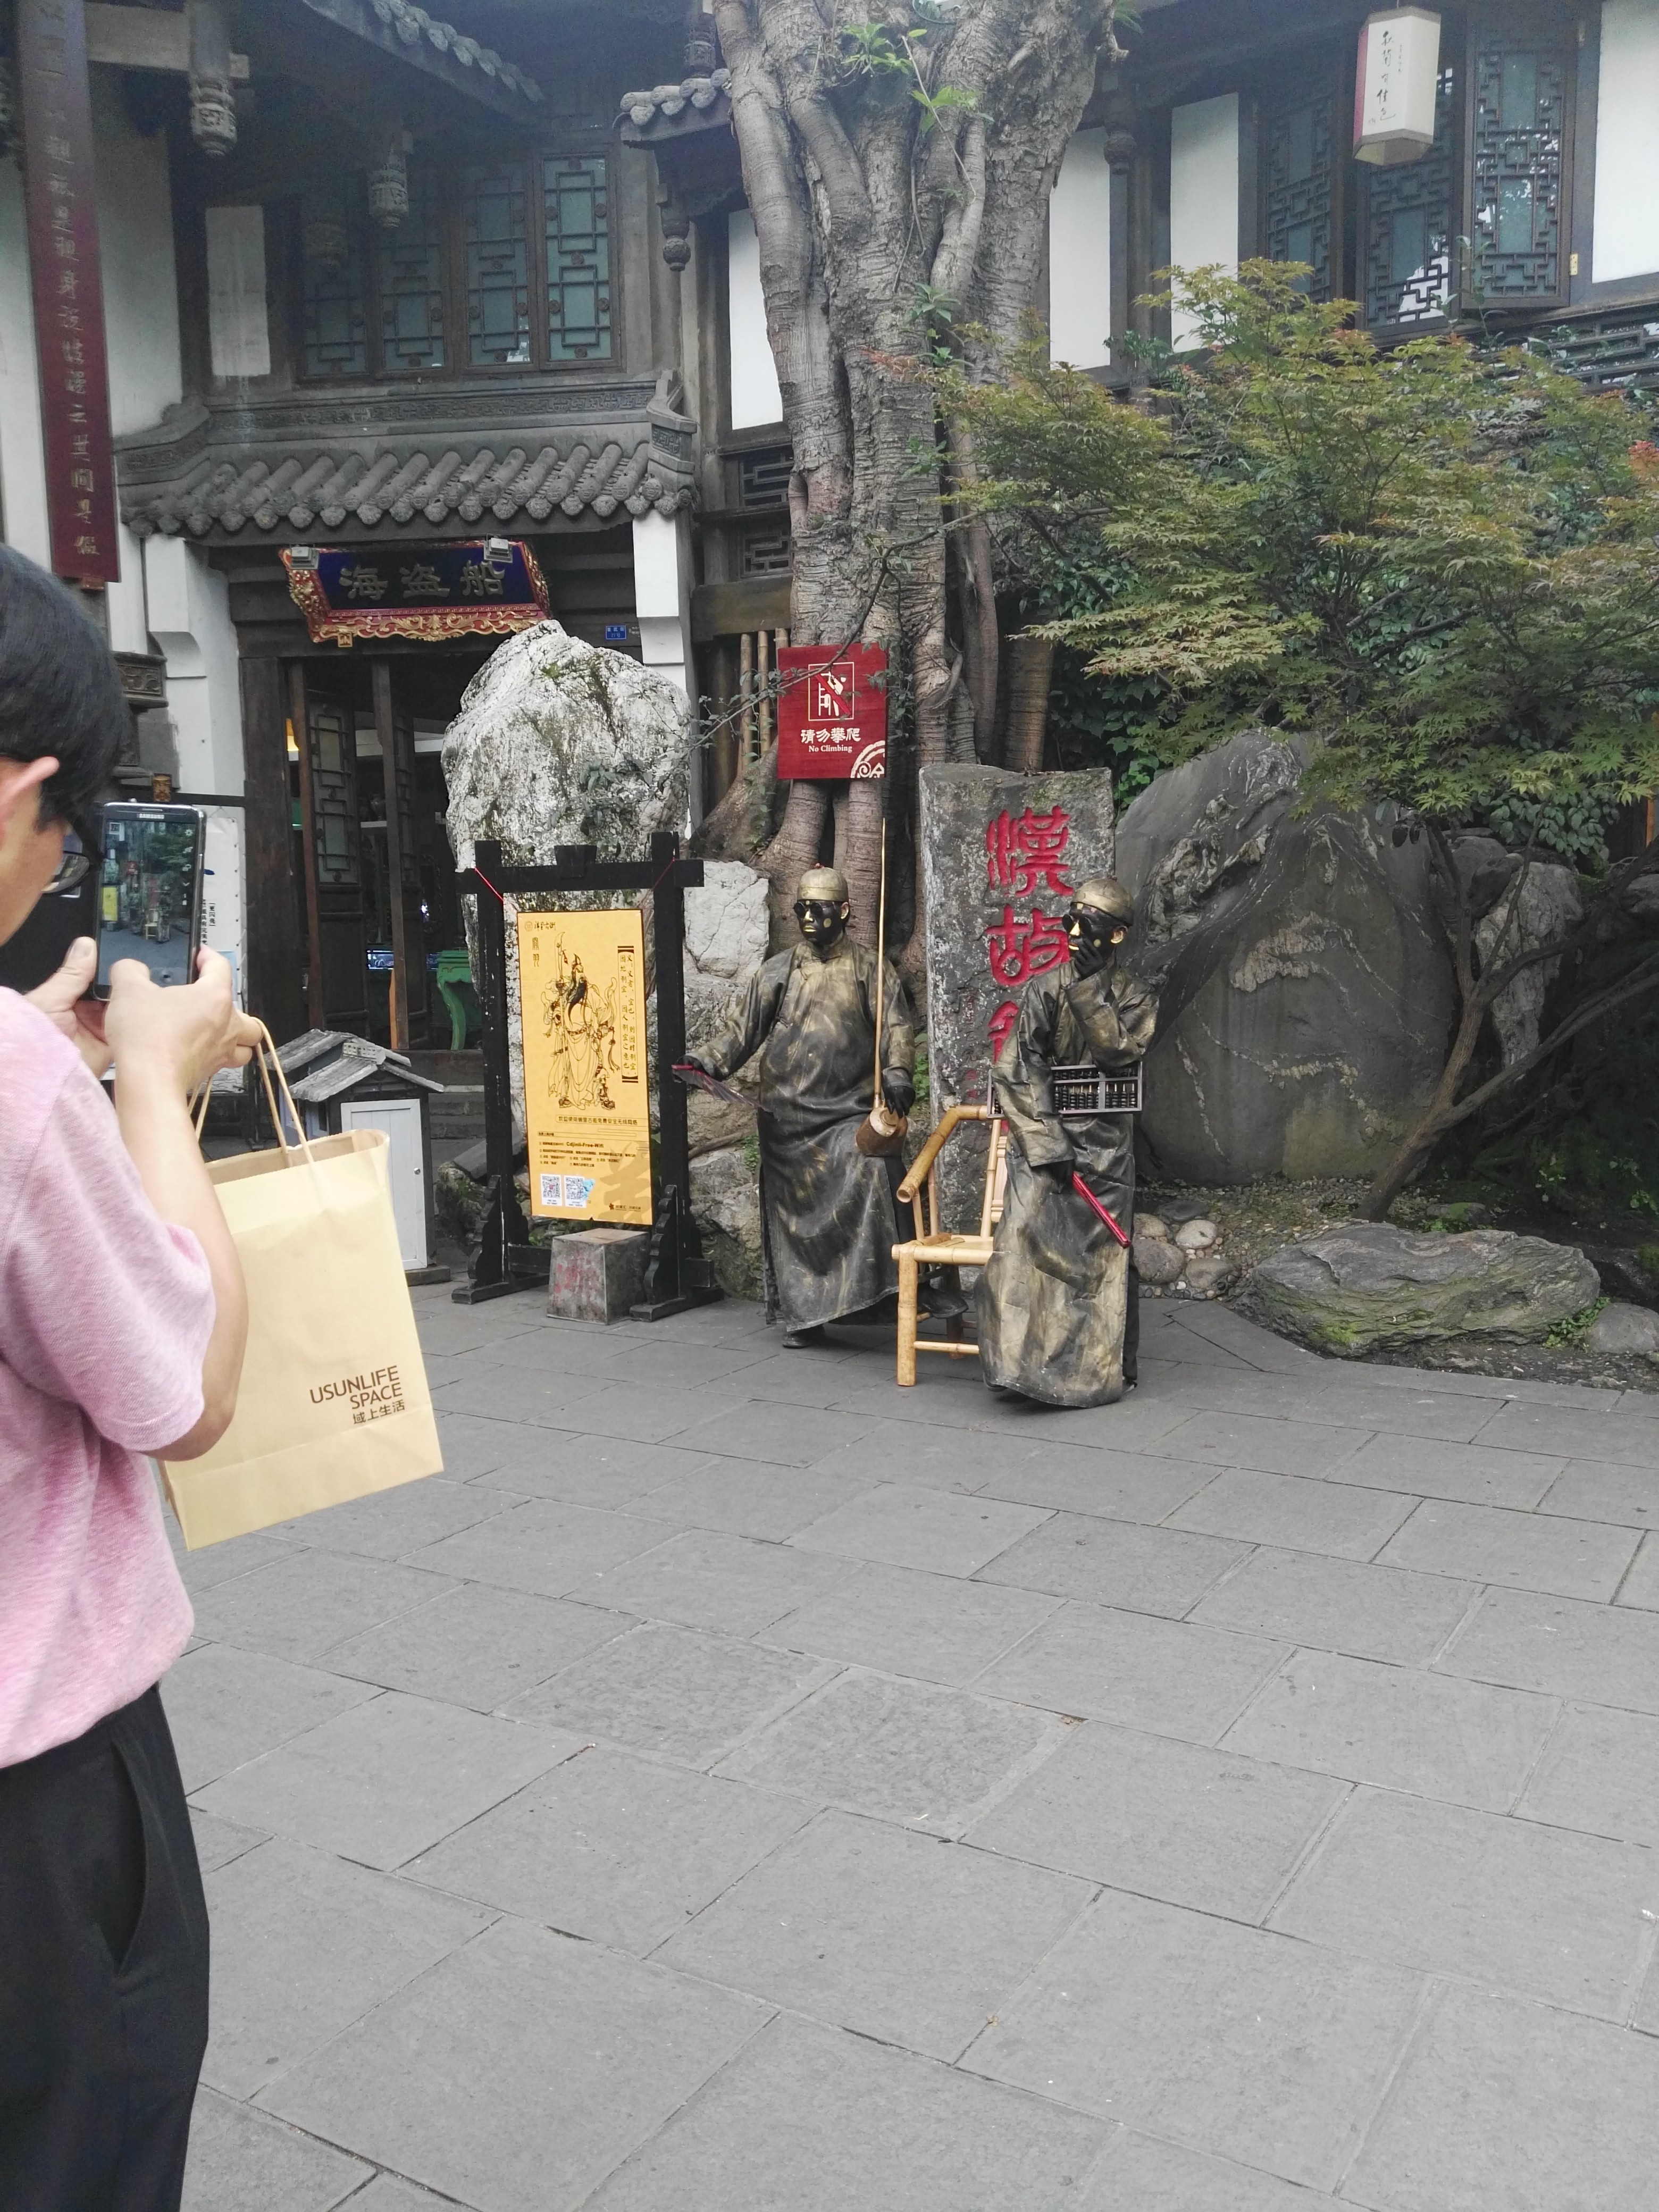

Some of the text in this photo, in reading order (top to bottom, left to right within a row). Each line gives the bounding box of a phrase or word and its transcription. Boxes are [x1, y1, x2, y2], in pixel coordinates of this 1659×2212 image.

[339, 559, 506, 600] 海盗船
[800, 727, 861, 744] 请勿攀爬
[820, 744, 852, 753] Climbing
[309, 1365, 399, 1404] USUNLIFE
[349, 1382, 403, 1410] SPACE
[353, 1399, 405, 1425] 域上生活
